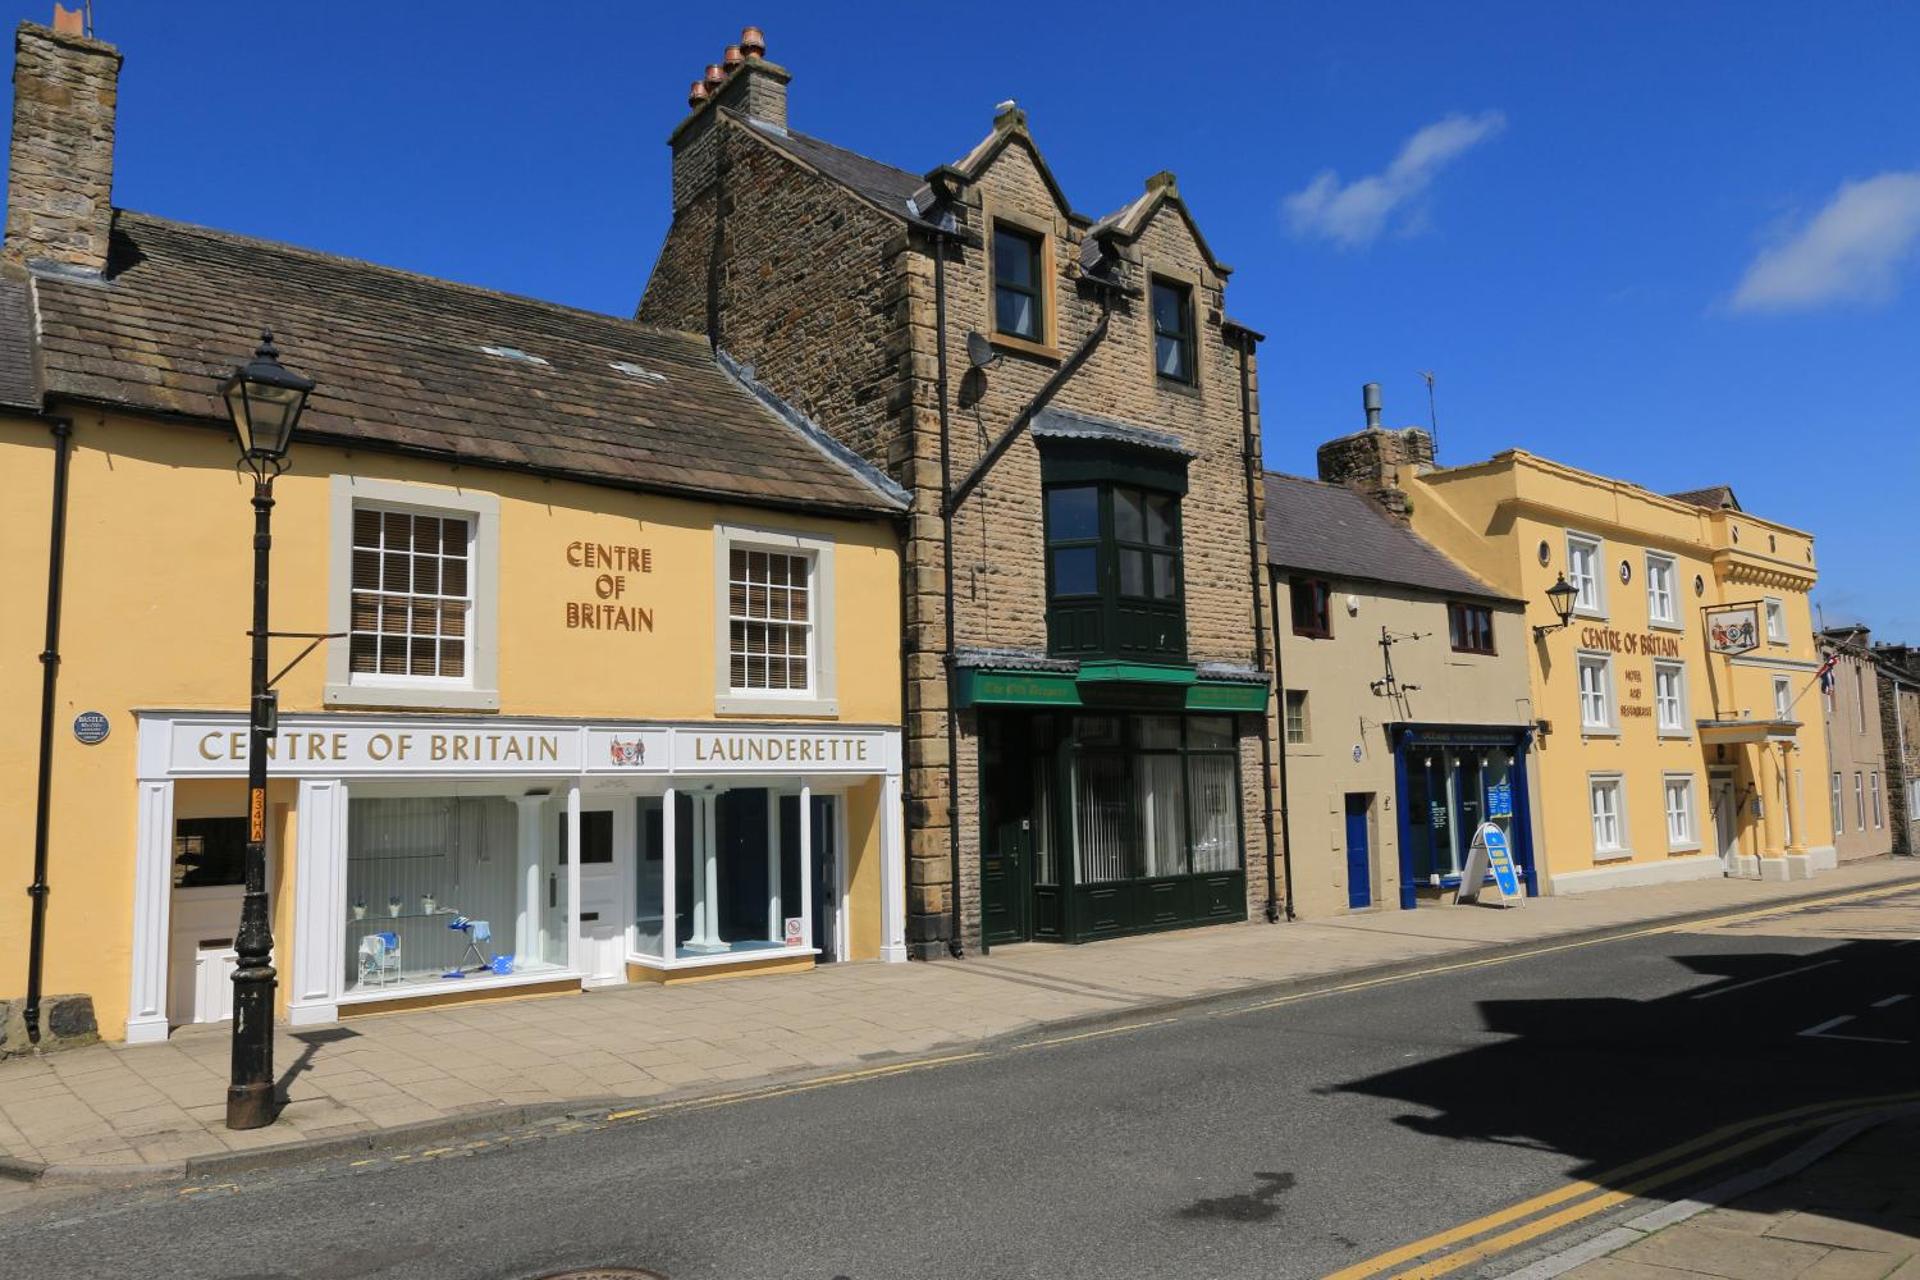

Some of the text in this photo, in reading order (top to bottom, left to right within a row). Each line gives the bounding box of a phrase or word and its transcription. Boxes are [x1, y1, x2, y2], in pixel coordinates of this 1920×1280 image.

[566, 541, 652, 573] CENTRE
[595, 574, 626, 601] OF
[566, 602, 654, 632] BRITAIN
[1581, 626, 1679, 658] CENTRE OF BRITAIN
[366, 733, 413, 761] OF
[430, 735, 559, 761] BRITAIN
[694, 736, 868, 761] LAUNDERETTE
